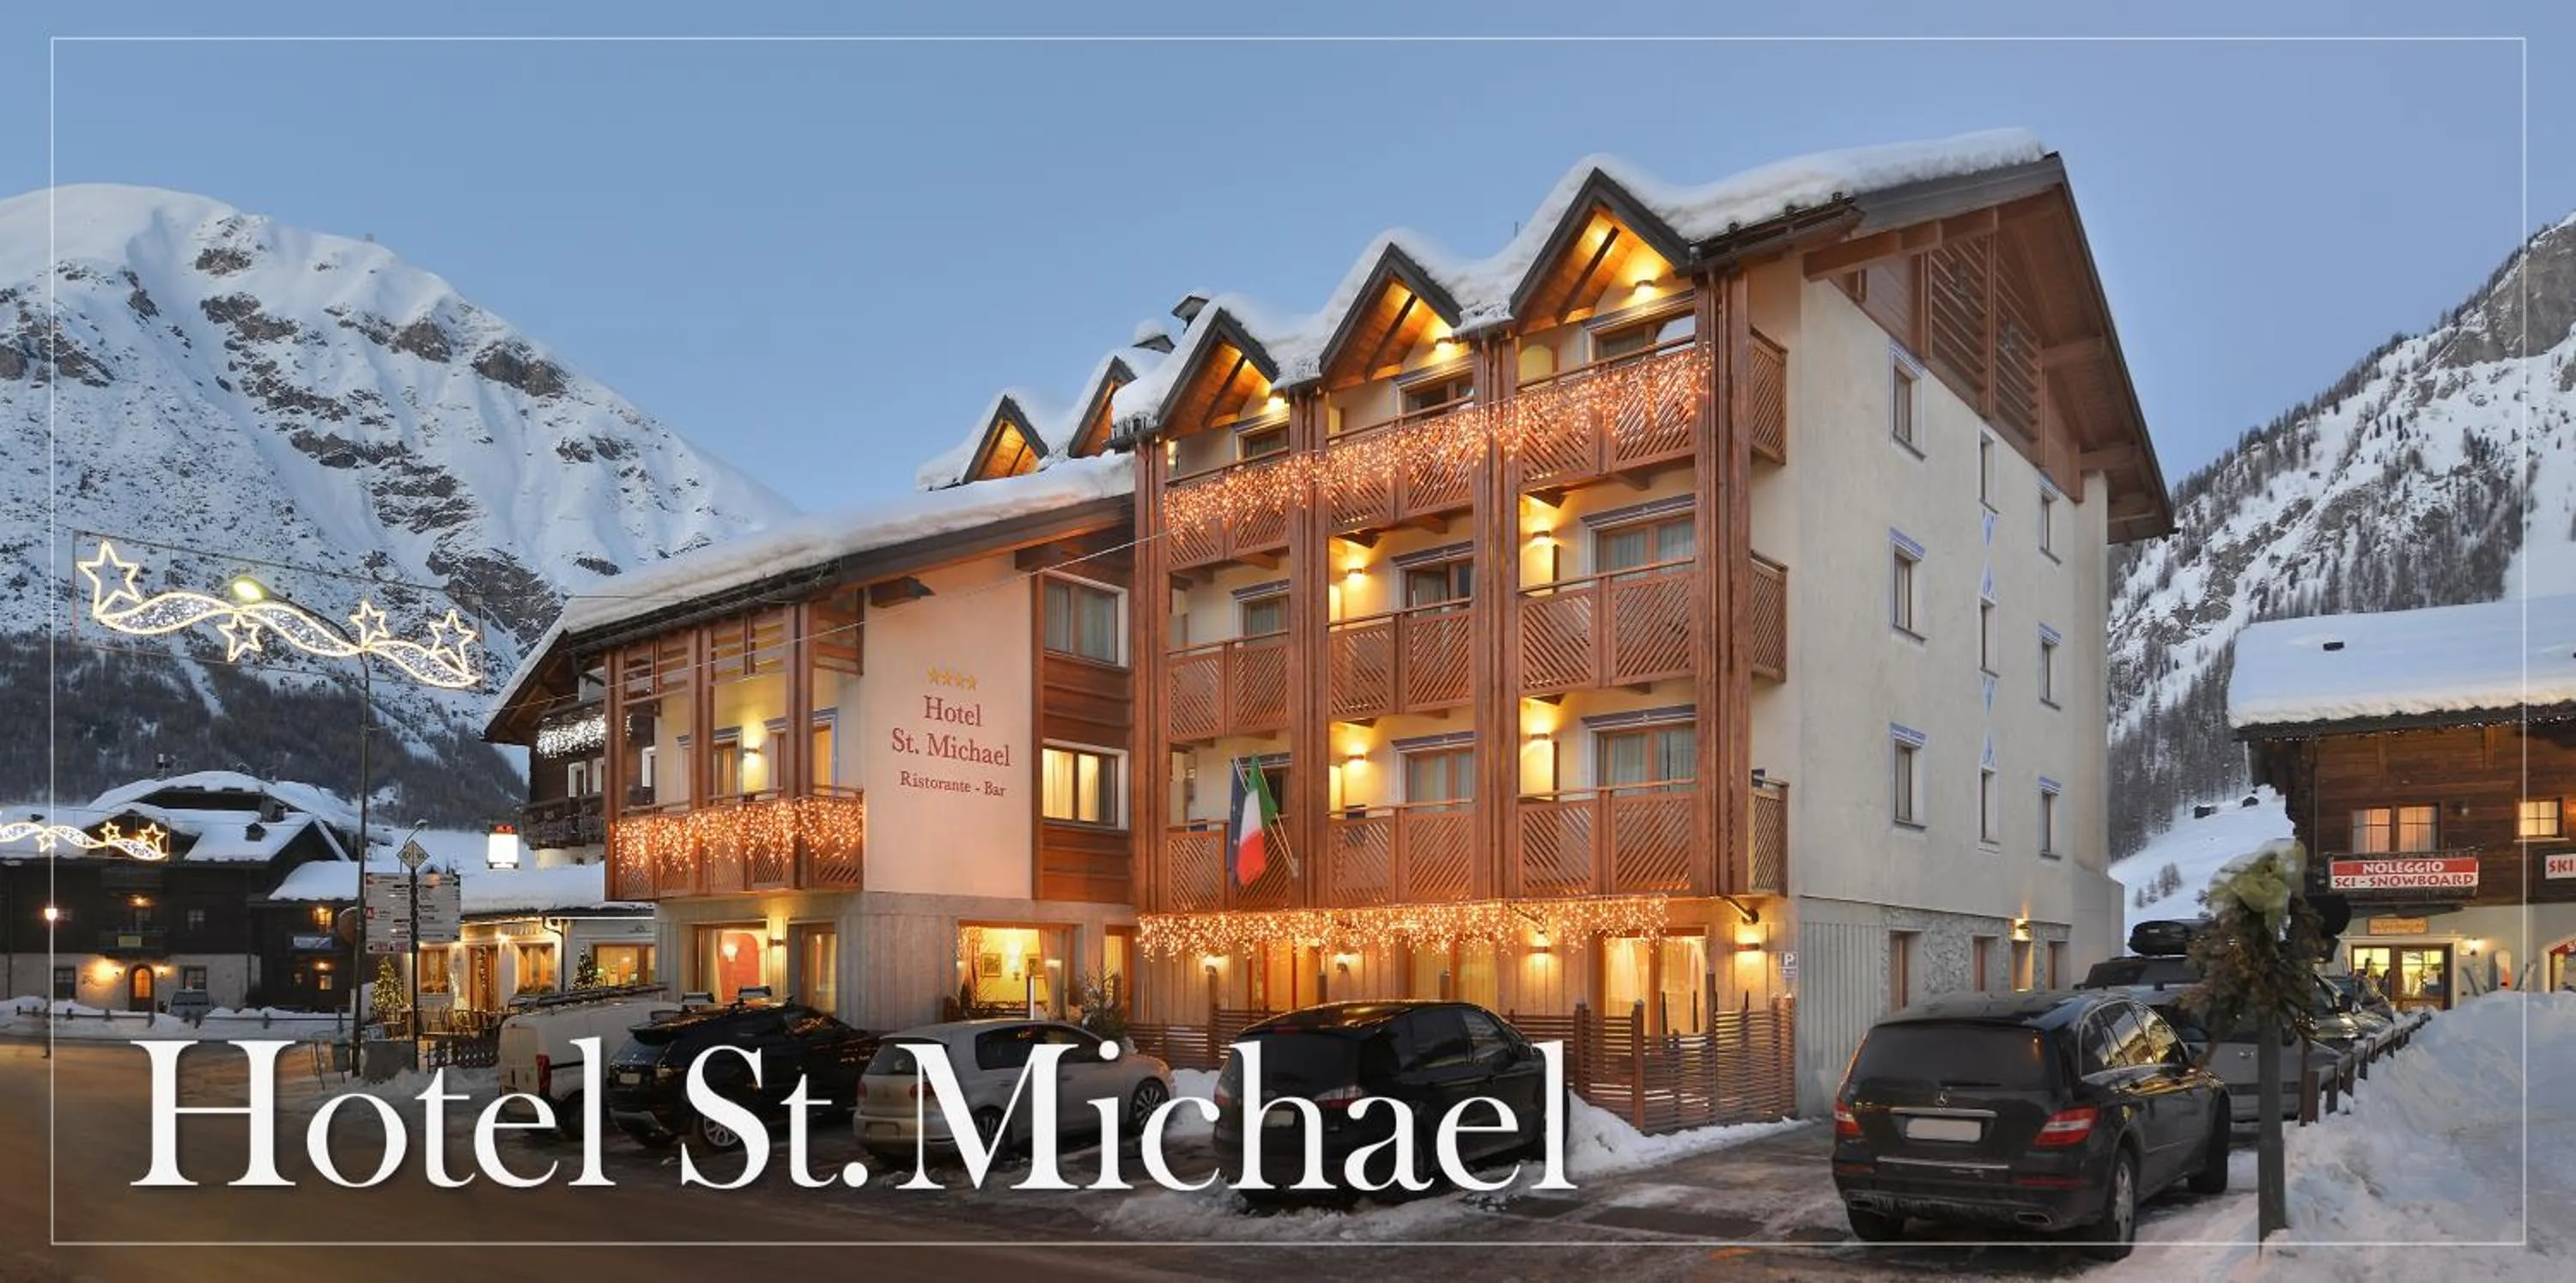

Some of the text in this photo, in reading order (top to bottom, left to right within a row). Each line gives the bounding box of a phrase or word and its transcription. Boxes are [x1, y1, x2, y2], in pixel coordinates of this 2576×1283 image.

[923, 695, 982, 727] Hotel
[892, 727, 1011, 766] St. Michael
[900, 771, 971, 793] Ristorante
[984, 781, 1006, 797] Bar
[2362, 861, 2445, 874] NOLEGGIO
[2549, 860, 2573, 873] SKI
[2335, 877, 2355, 887] SCI
[2370, 874, 2474, 887] SNOWBOARD
[1784, 953, 1794, 965] P
